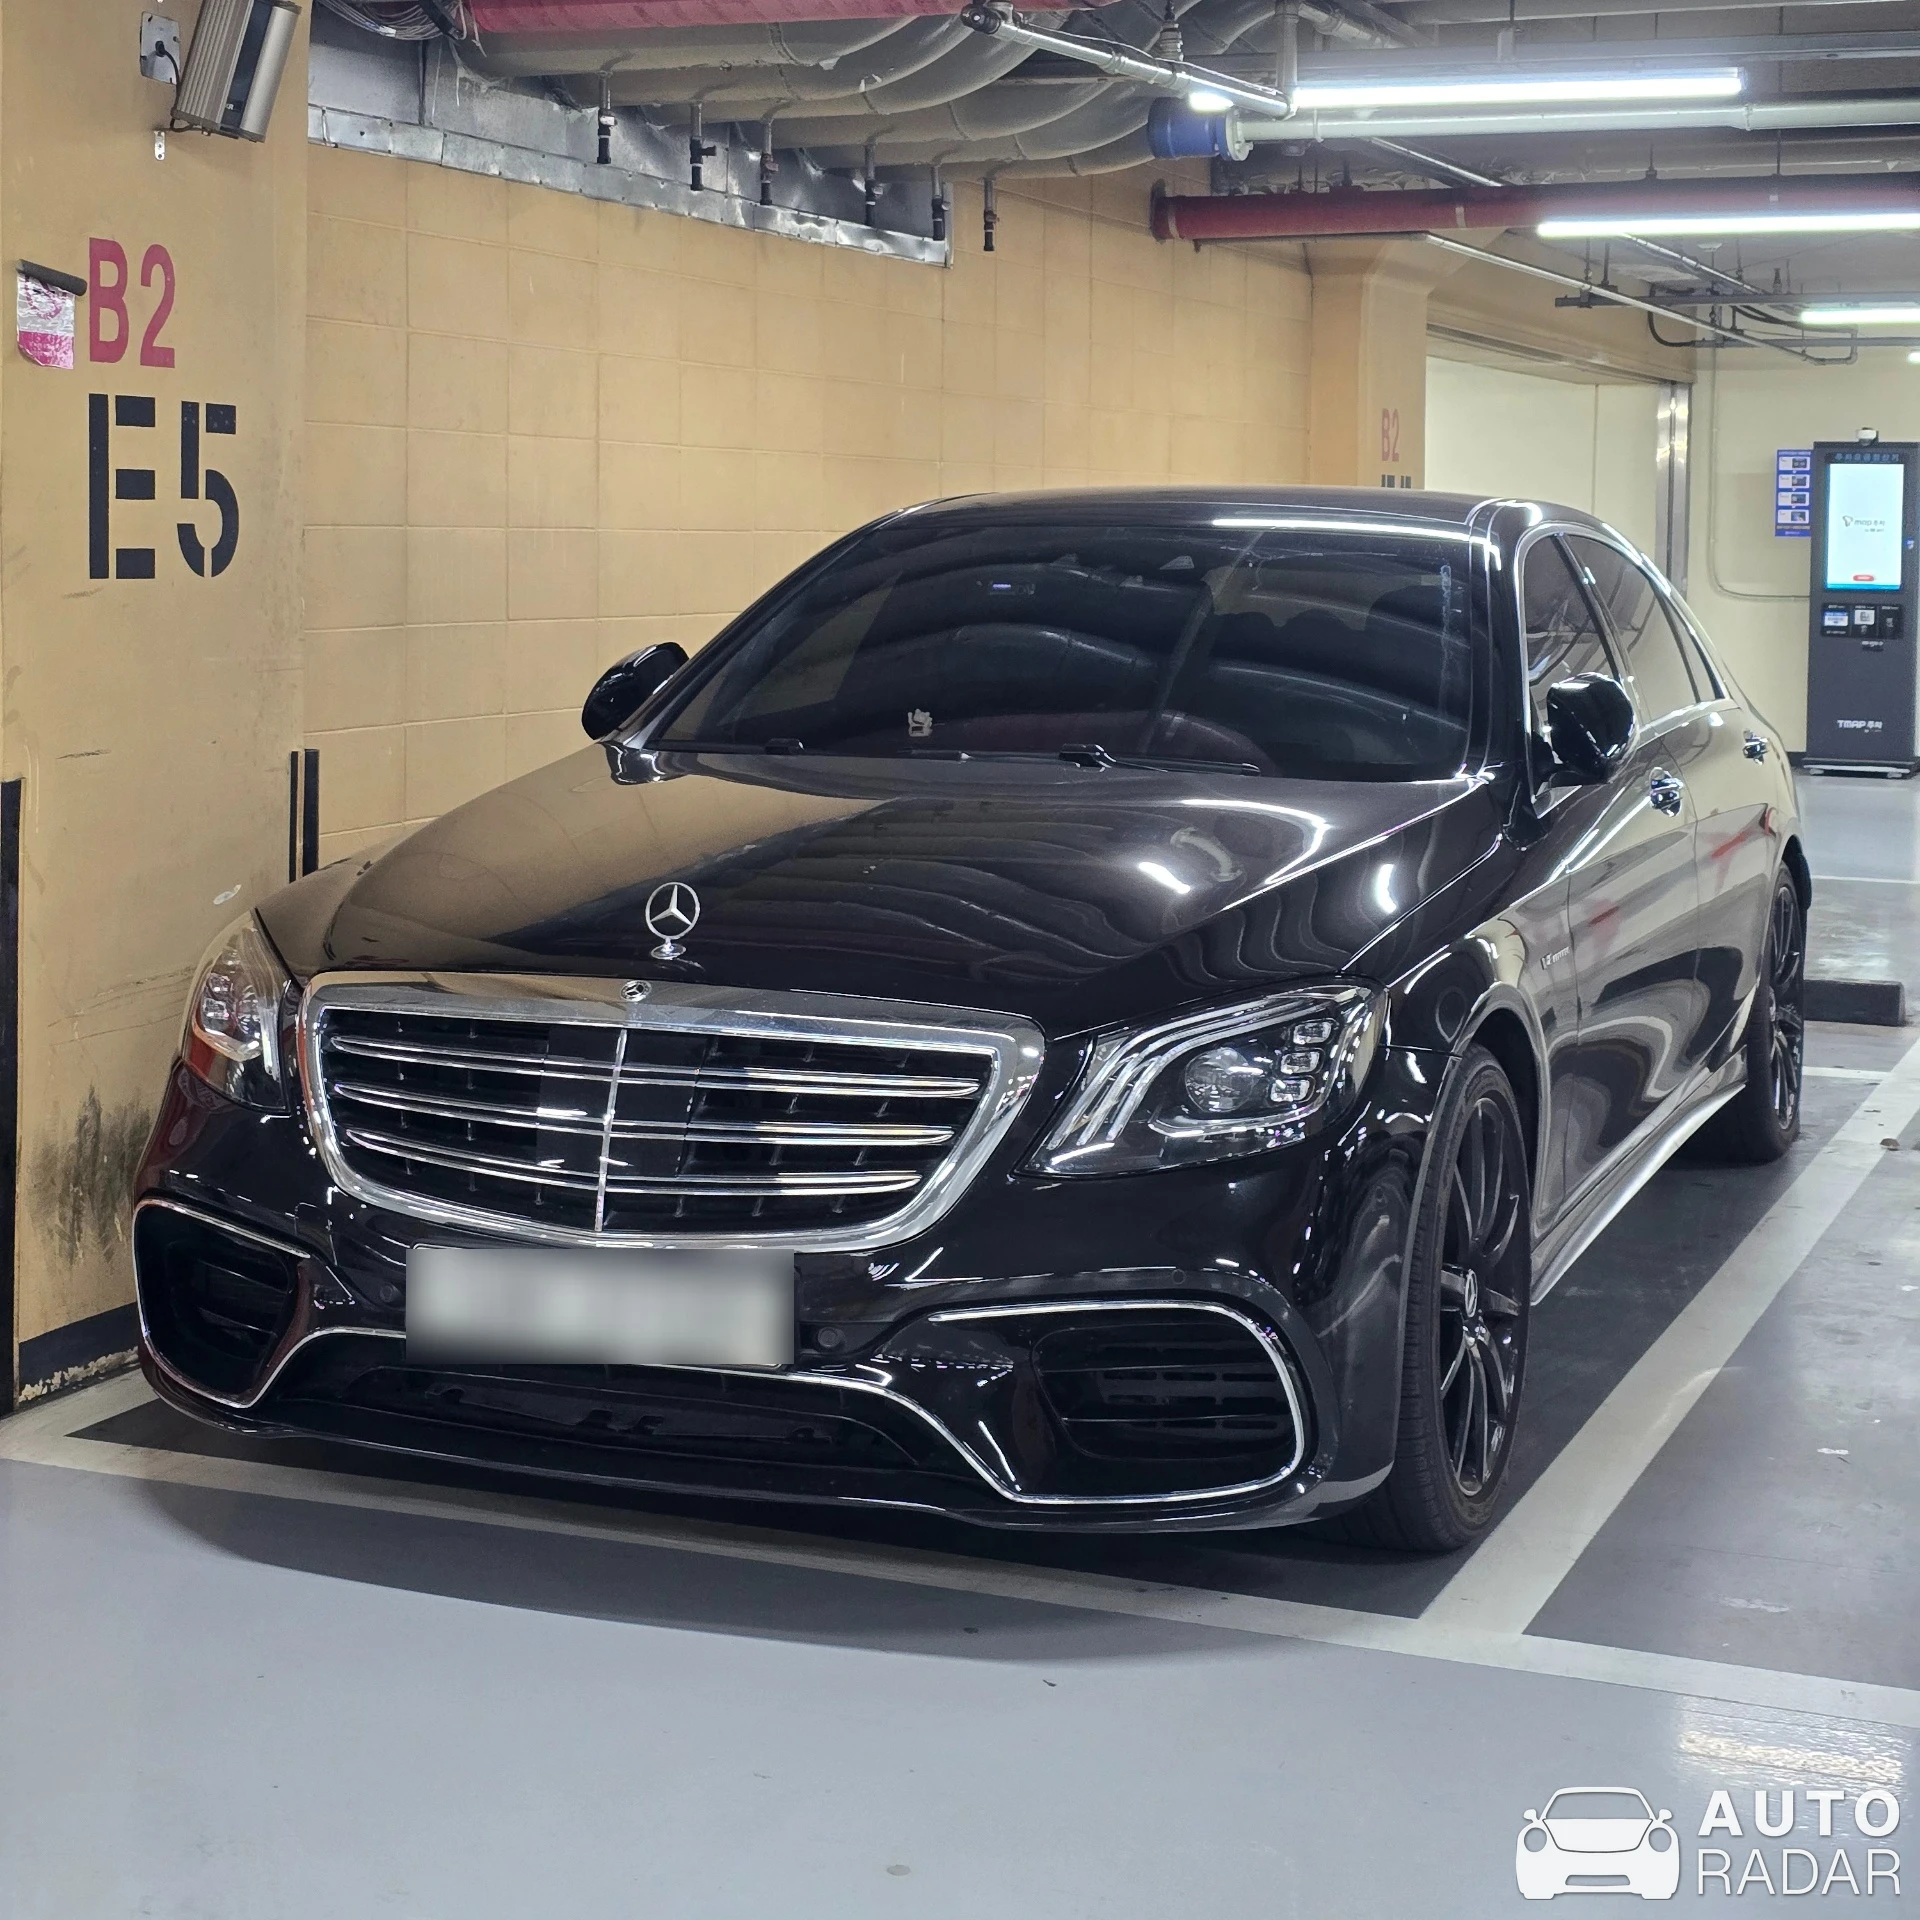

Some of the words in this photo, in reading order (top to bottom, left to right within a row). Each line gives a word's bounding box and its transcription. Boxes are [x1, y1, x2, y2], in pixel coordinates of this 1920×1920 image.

[88, 237, 176, 369] B2
[1381, 408, 1400, 462] B2
[88, 393, 240, 580] E5
[1837, 719, 1866, 729] TMAP
